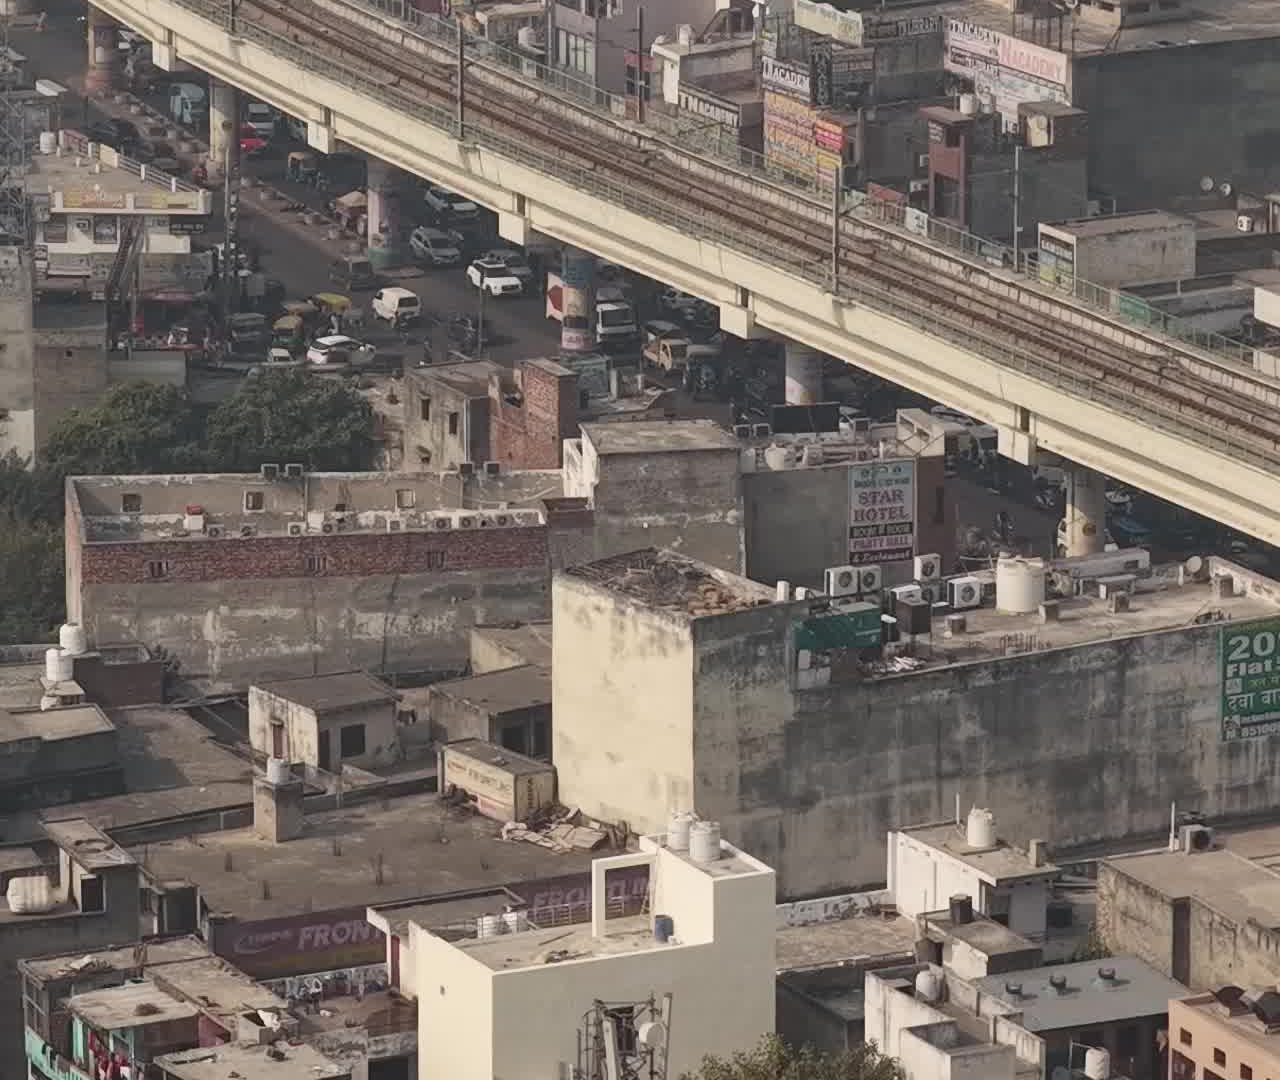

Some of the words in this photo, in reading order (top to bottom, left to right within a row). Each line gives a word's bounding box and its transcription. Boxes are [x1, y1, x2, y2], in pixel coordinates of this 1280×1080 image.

[859, 489, 904, 506] STAR
[853, 506, 911, 522] HOTEL
[1226, 659, 1273, 678] Flat
